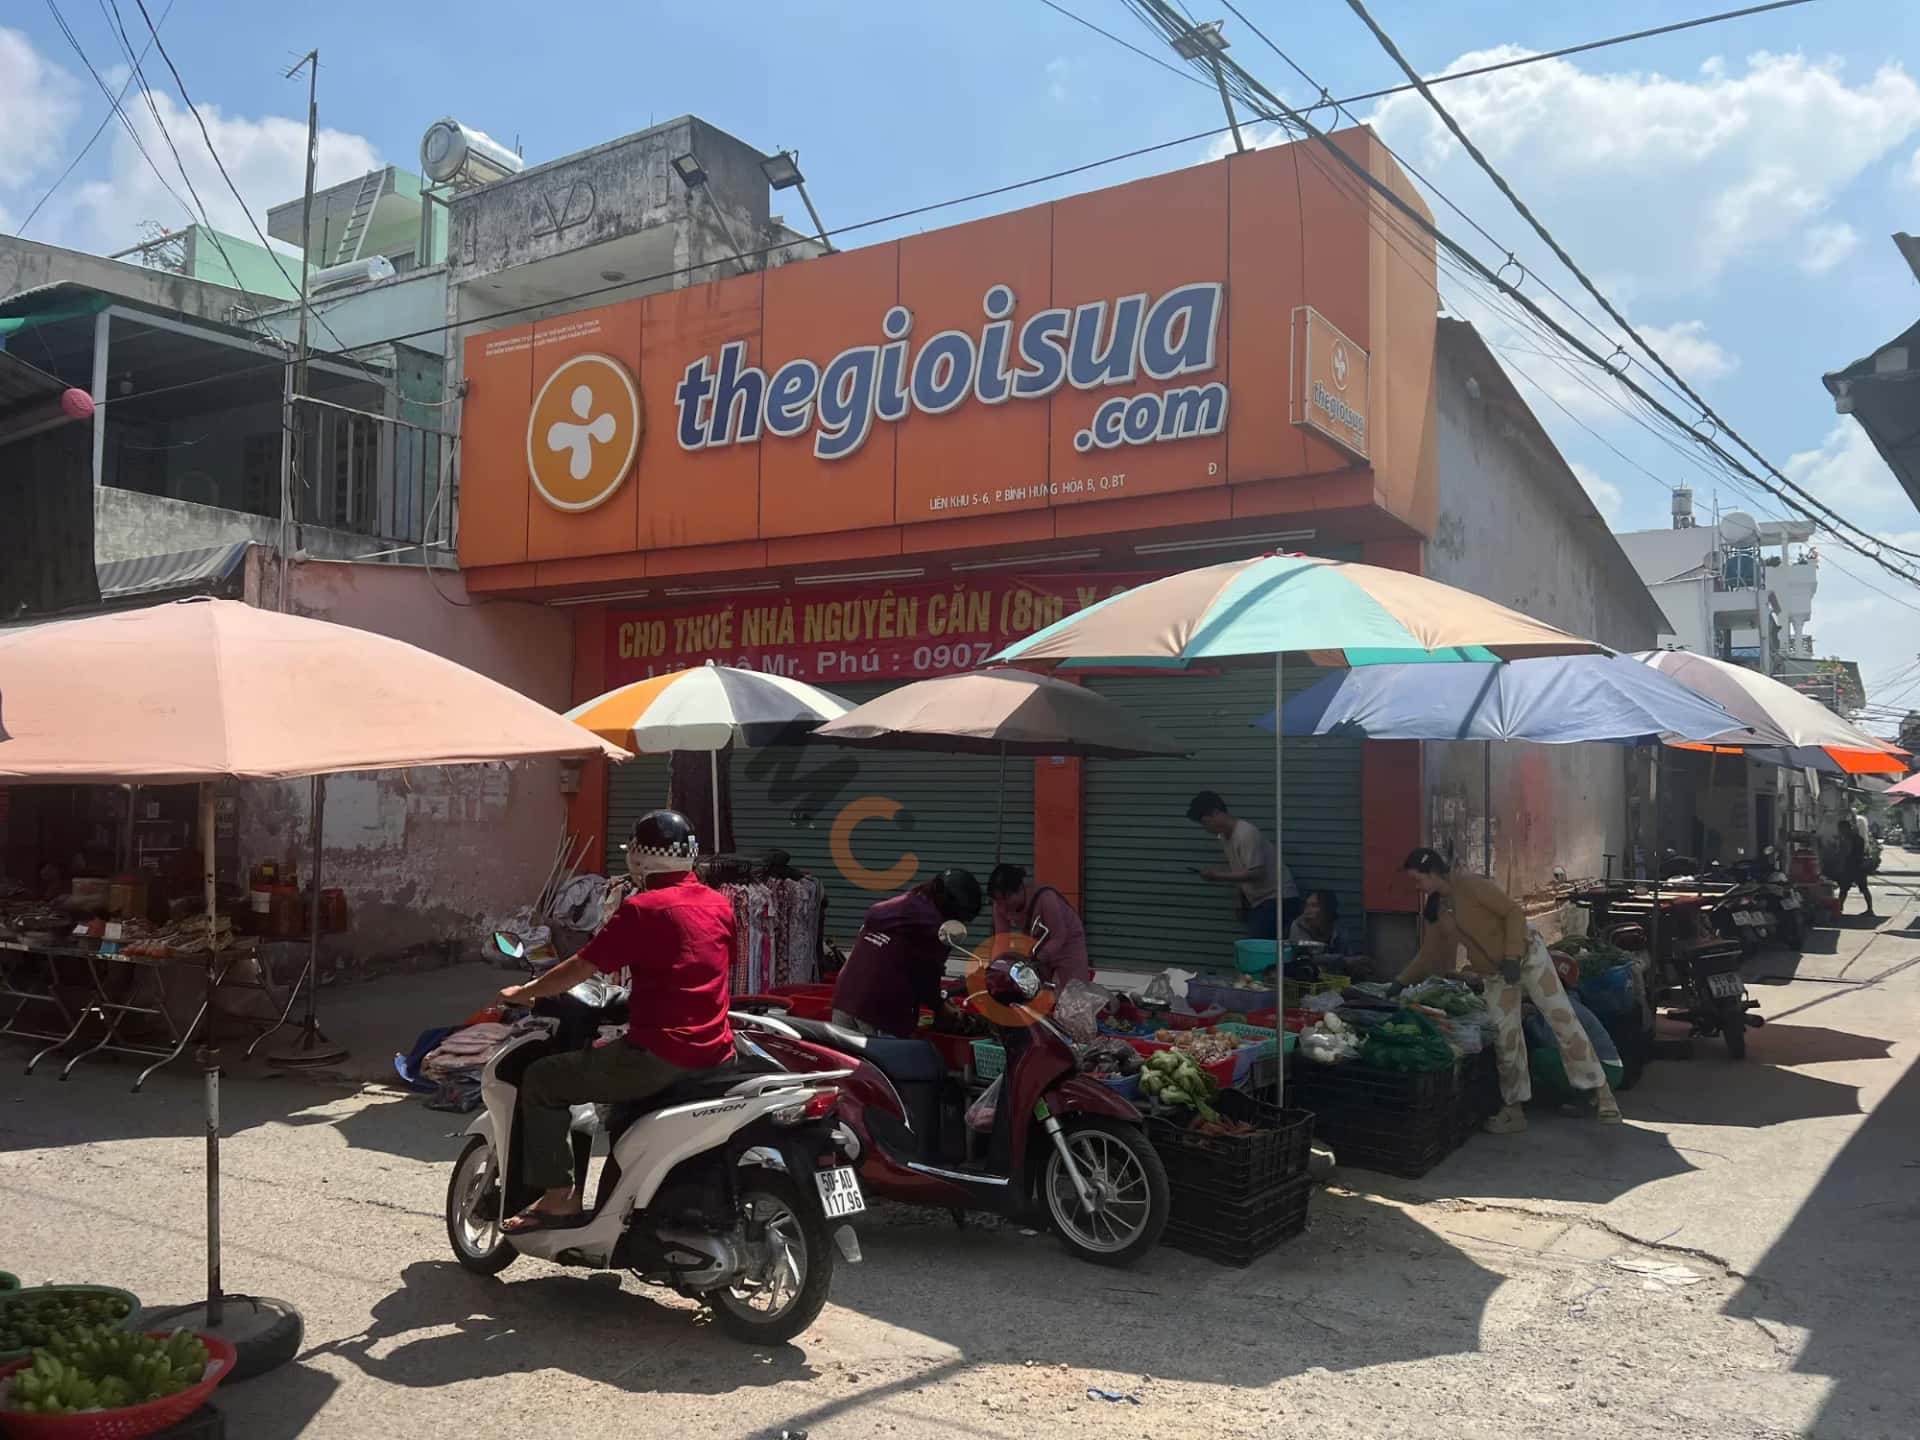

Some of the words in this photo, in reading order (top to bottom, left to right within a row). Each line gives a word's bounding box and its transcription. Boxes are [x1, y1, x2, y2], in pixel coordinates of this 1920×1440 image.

[675, 282, 1223, 460] thegioisua
[1073, 381, 1228, 453] .com
[950, 493, 970, 508] KHU
[1100, 473, 1127, 490] Q.BT
[618, 620, 667, 659] CHO
[741, 597, 795, 648] NHÀ
[927, 583, 992, 637] CĂN
[762, 654, 805, 676] Mr.
[816, 648, 881, 674] Phú
[892, 652, 900, 672] :
[692, 1102, 747, 1118] VISION
[825, 1190, 862, 1216] 117.96
